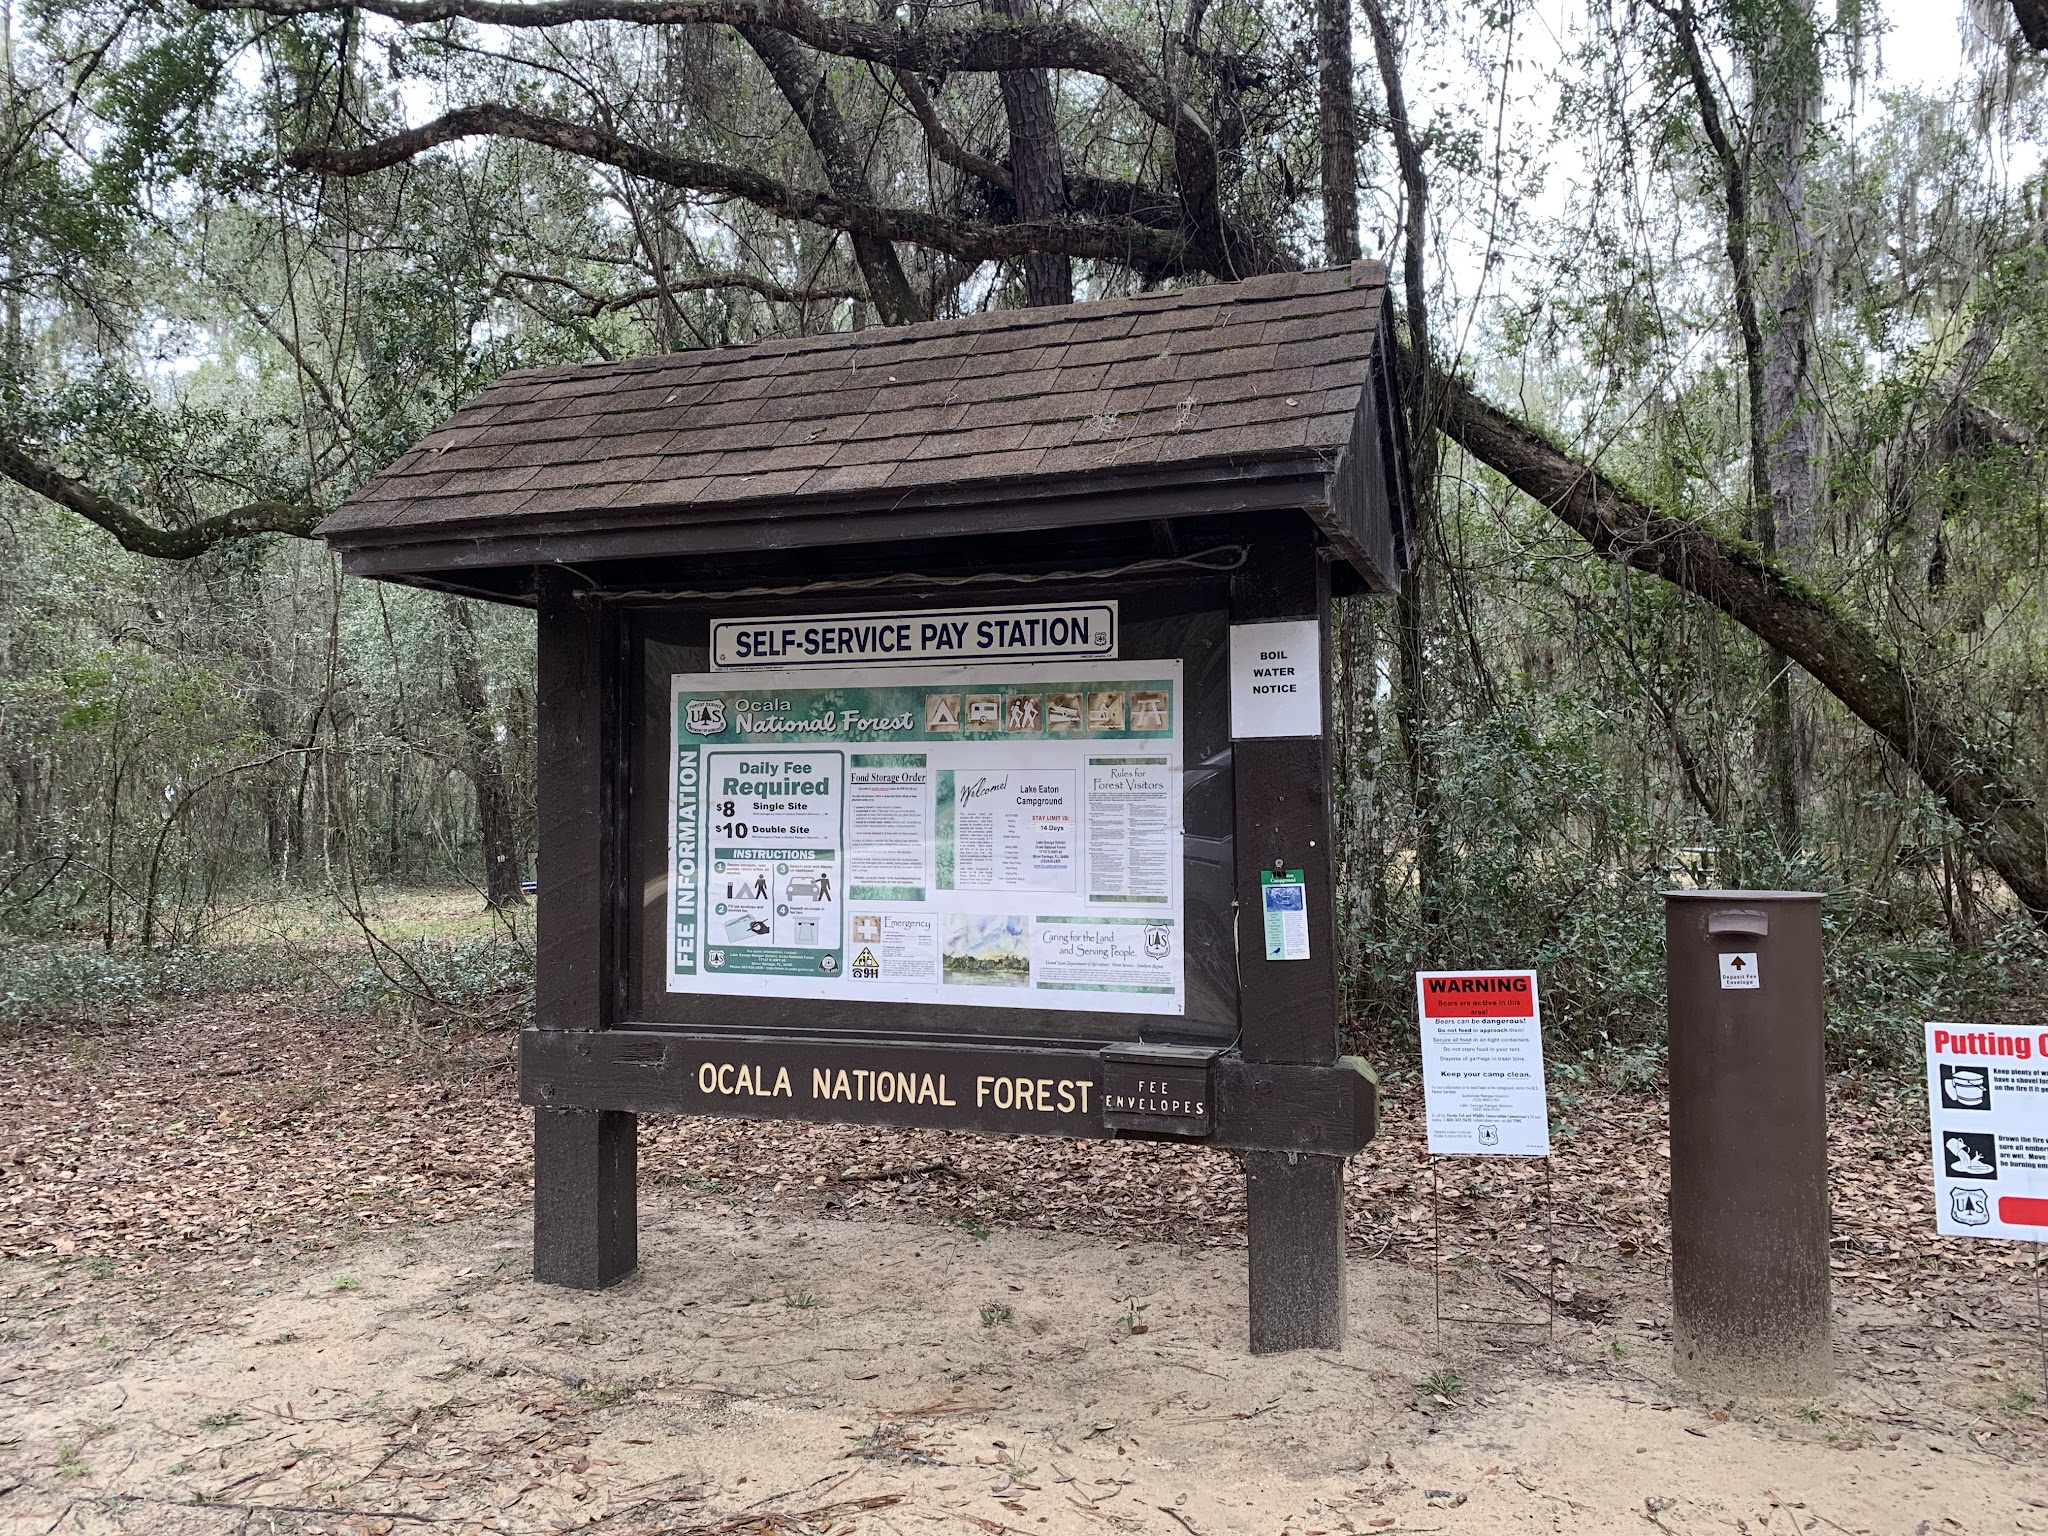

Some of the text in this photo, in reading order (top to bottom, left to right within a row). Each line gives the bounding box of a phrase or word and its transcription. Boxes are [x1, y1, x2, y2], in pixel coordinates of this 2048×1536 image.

[735, 624, 911, 658] SELF-SERVICE
[921, 621, 970, 651] PAY
[976, 616, 1089, 650] STATION
[1260, 651, 1288, 660] BOIL
[1253, 667, 1295, 677] WATER
[1253, 684, 1297, 694] NOTICE
[734, 698, 792, 712] Ocala
[735, 710, 837, 735] National
[839, 709, 915, 732] Forest
[739, 761, 812, 777] Daily Fee
[1111, 767, 1146, 779] Rules for
[850, 772, 927, 784] Food Storage Order
[1093, 778, 1164, 791] Forest Visitors
[722, 777, 830, 799] Required
[959, 774, 1009, 808] Welcome!
[1020, 784, 1060, 794] Lake Eaton
[1016, 796, 1063, 807] Campground
[716, 800, 808, 818] $8 Single Site
[715, 822, 748, 840] $10
[752, 825, 786, 834] Double
[789, 824, 810, 834] Site
[677, 750, 698, 968] FEE INFORMATION
[732, 849, 816, 860] INSTRUCTIONS
[884, 915, 931, 931] Emergency
[1042, 930, 1114, 945] Caring for the Land
[1059, 944, 1074, 955] and
[1075, 944, 1109, 960] Serving
[1110, 944, 1137, 961] People.
[863, 968, 879, 979] 911
[1428, 978, 1527, 993] WARNING
[1481, 1018, 1526, 1026] dangerous!
[1934, 1029, 2032, 1060] Putting
[1506, 1070, 1532, 1078] clean.
[698, 1061, 1094, 1114] OCALA NATIONAL FOREST
[1138, 1080, 1169, 1095] FEE
[1105, 1094, 1205, 1115] ENVELOPES
[2032, 1136, 2045, 1144] fire
[2028, 1153, 2046, 1161] Move
[2009, 1161, 2036, 1169] burning
